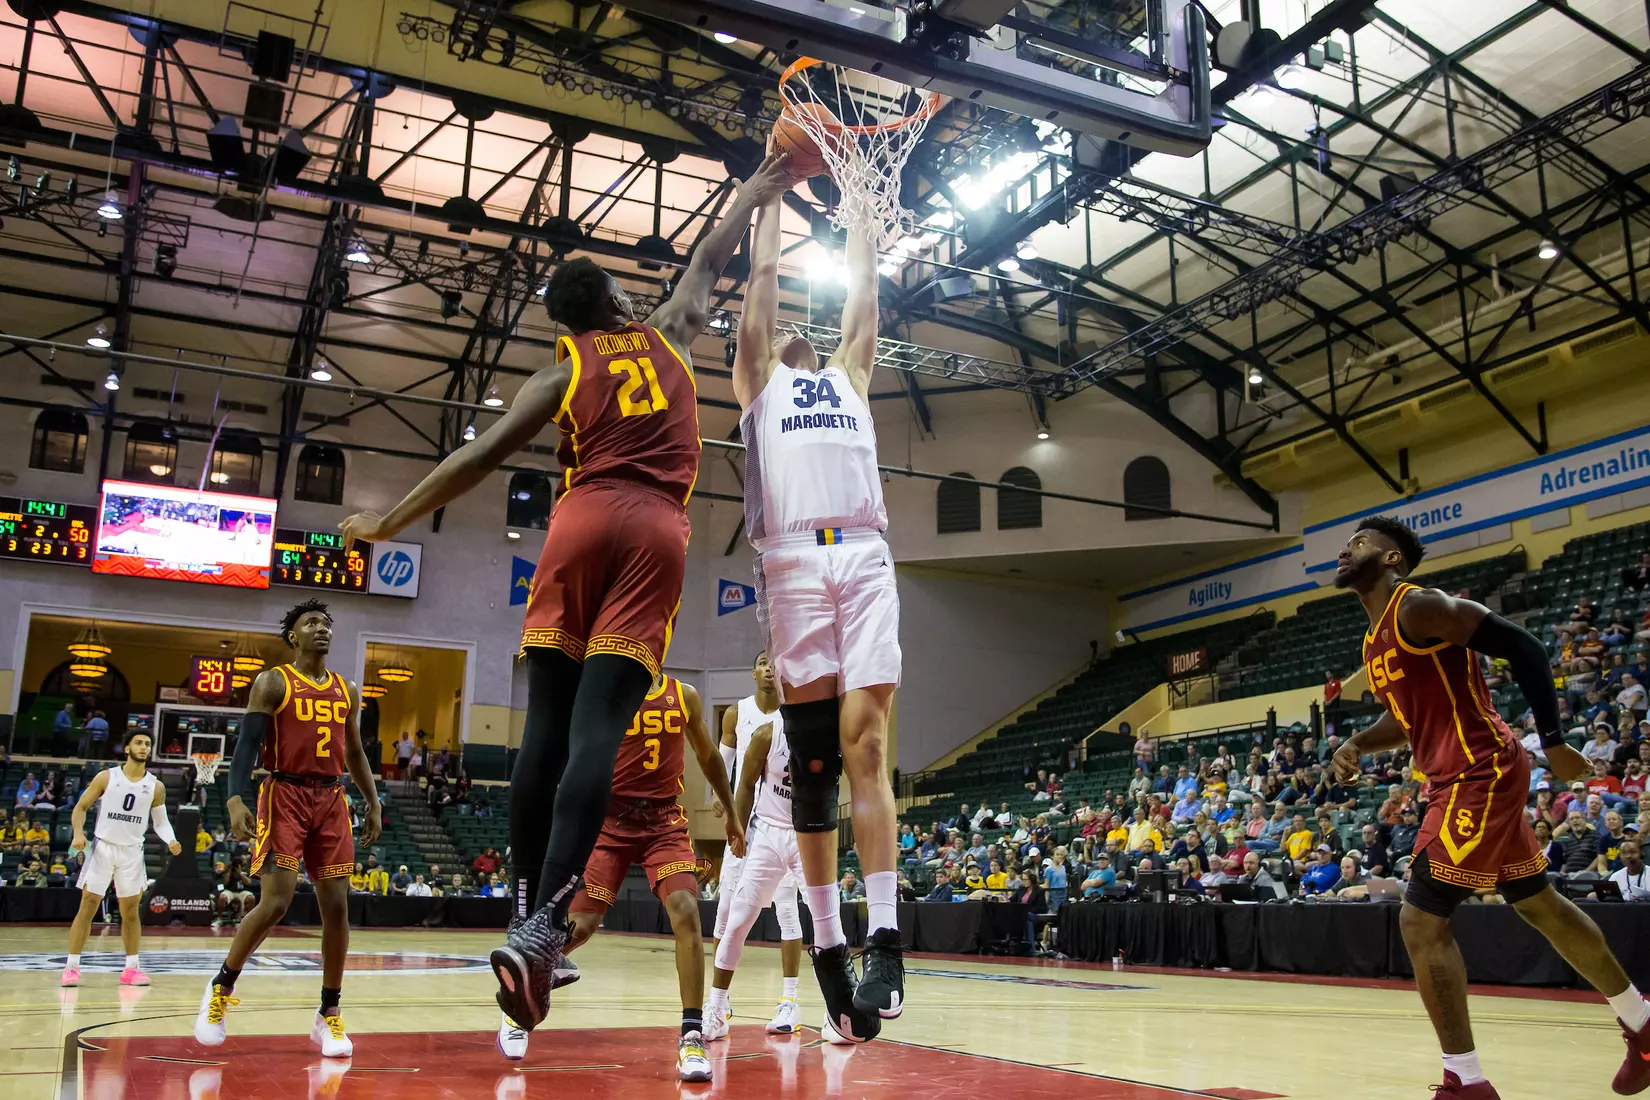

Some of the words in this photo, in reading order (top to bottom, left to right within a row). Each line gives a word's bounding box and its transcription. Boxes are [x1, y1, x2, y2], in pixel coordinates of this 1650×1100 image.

[593, 332, 650, 355] OKONGWU
[608, 357, 669, 417] 21
[793, 377, 841, 408] 34
[781, 413, 858, 433] MARQUETTE
[1540, 447, 1650, 495] Adrenalin
[27, 501, 65, 517] 14:41
[35, 525, 45, 537] 2
[69, 528, 89, 543] 50
[8, 540, 17, 551] 3
[78, 547, 86, 559] 3
[282, 551, 300, 565] 64
[317, 555, 326, 567] 2
[347, 558, 364, 572] 50
[295, 569, 302, 581] 3
[380, 551, 413, 587] hp
[355, 575, 362, 587] 3
[1189, 581, 1232, 607] Agility
[199, 660, 231, 672] 14:41
[1172, 651, 1201, 674] HOME
[198, 671, 225, 693] 20
[294, 698, 348, 724] USC
[316, 726, 331, 757] 2
[643, 738, 660, 770] 3
[773, 784, 792, 800] MAR
[122, 793, 136, 811] 0
[107, 812, 142, 824] MARQUETTE
